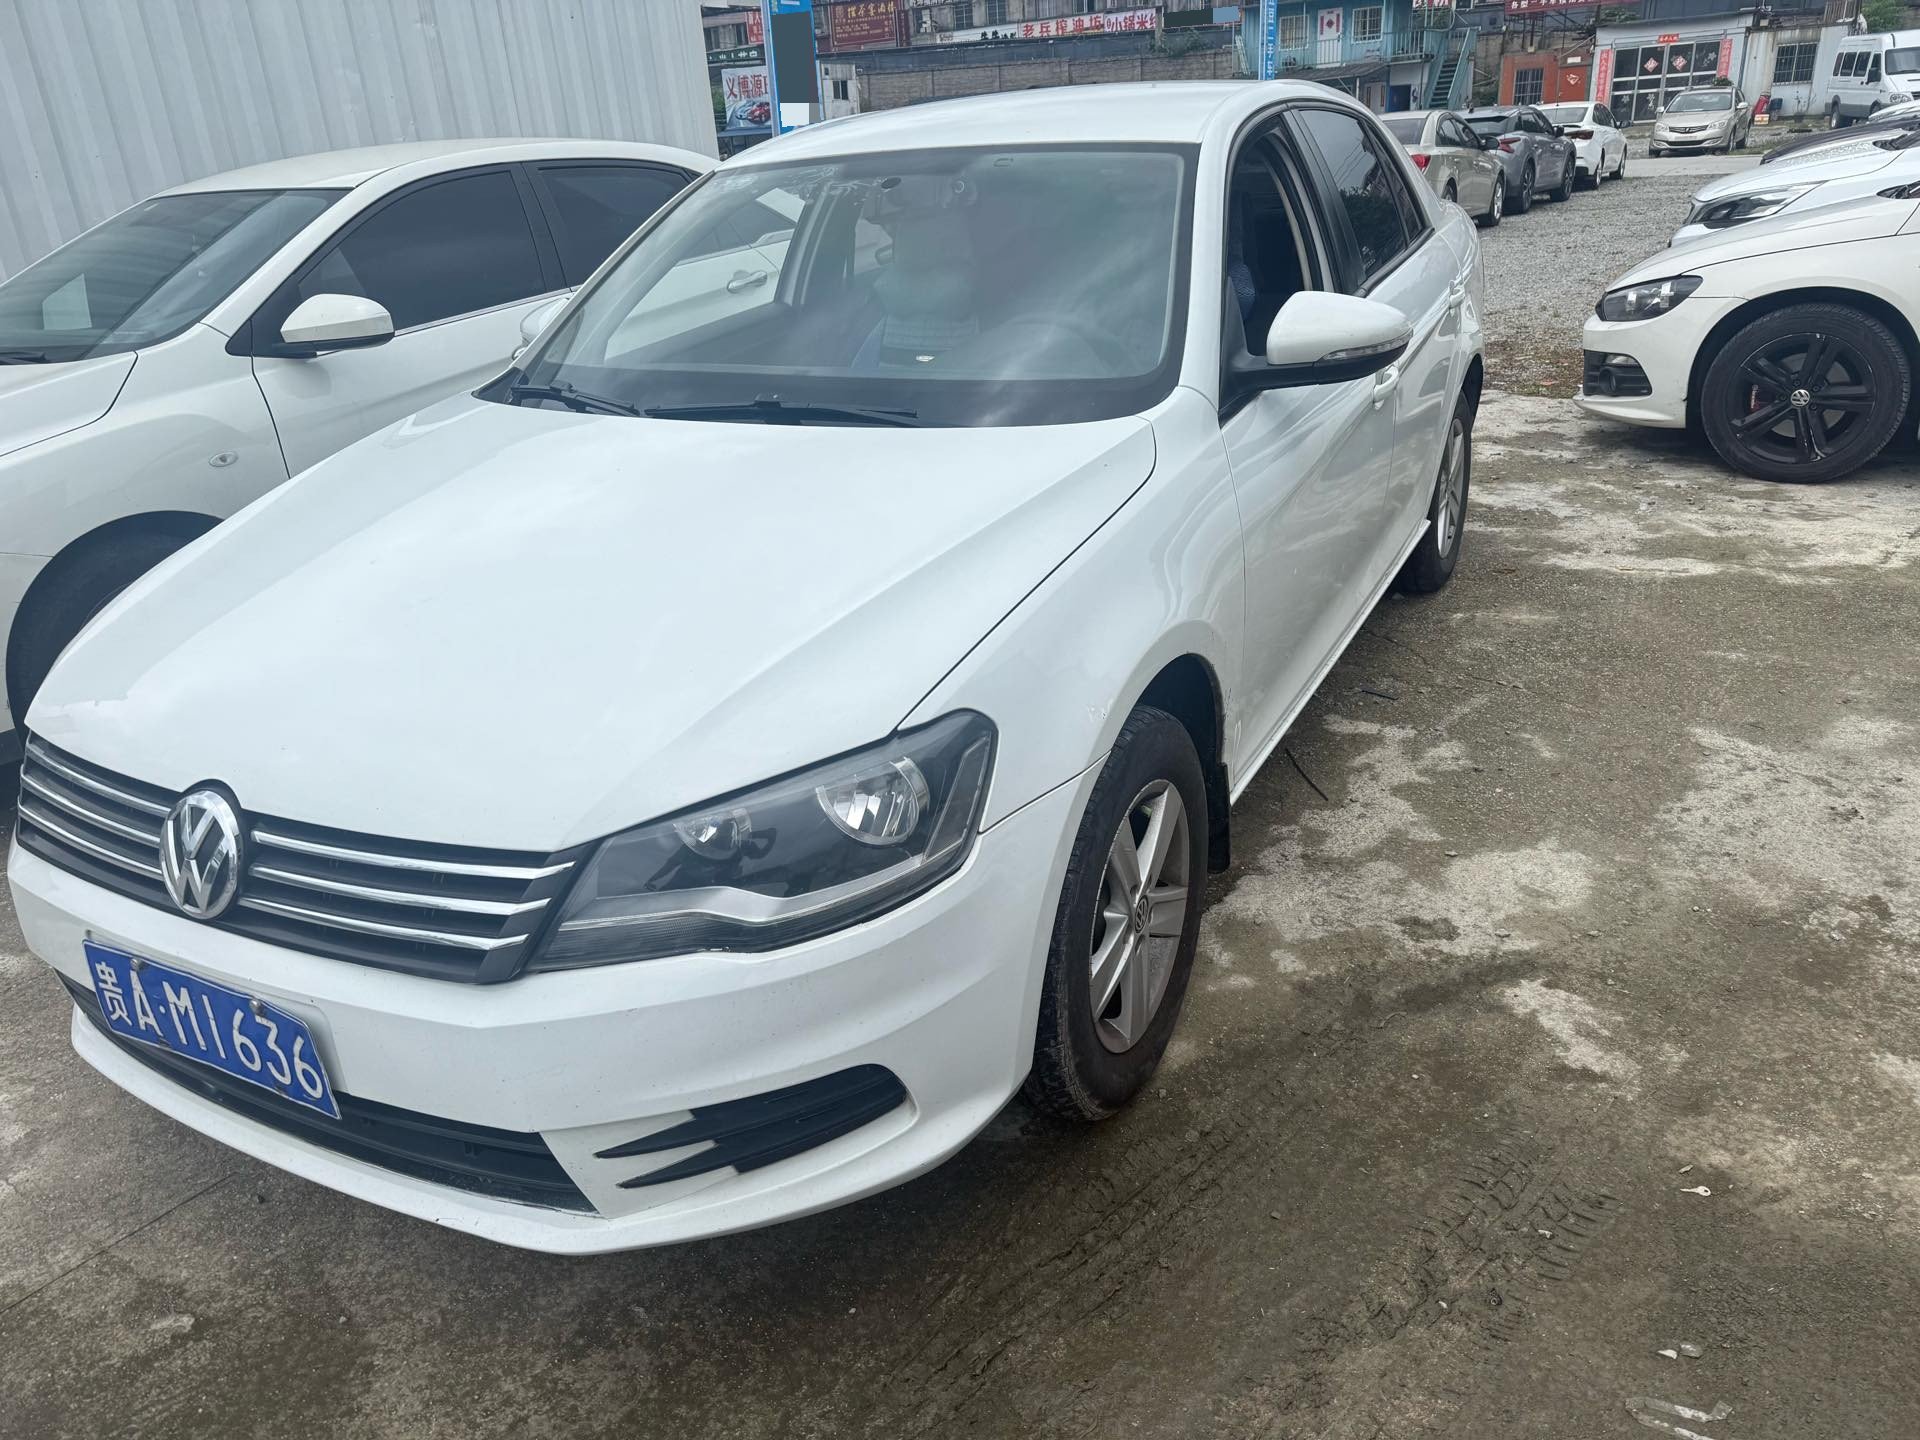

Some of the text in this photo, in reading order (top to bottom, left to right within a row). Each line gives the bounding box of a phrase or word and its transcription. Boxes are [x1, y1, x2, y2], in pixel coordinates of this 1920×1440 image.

[1022, 15, 1103, 38] 老兵榨油坊
